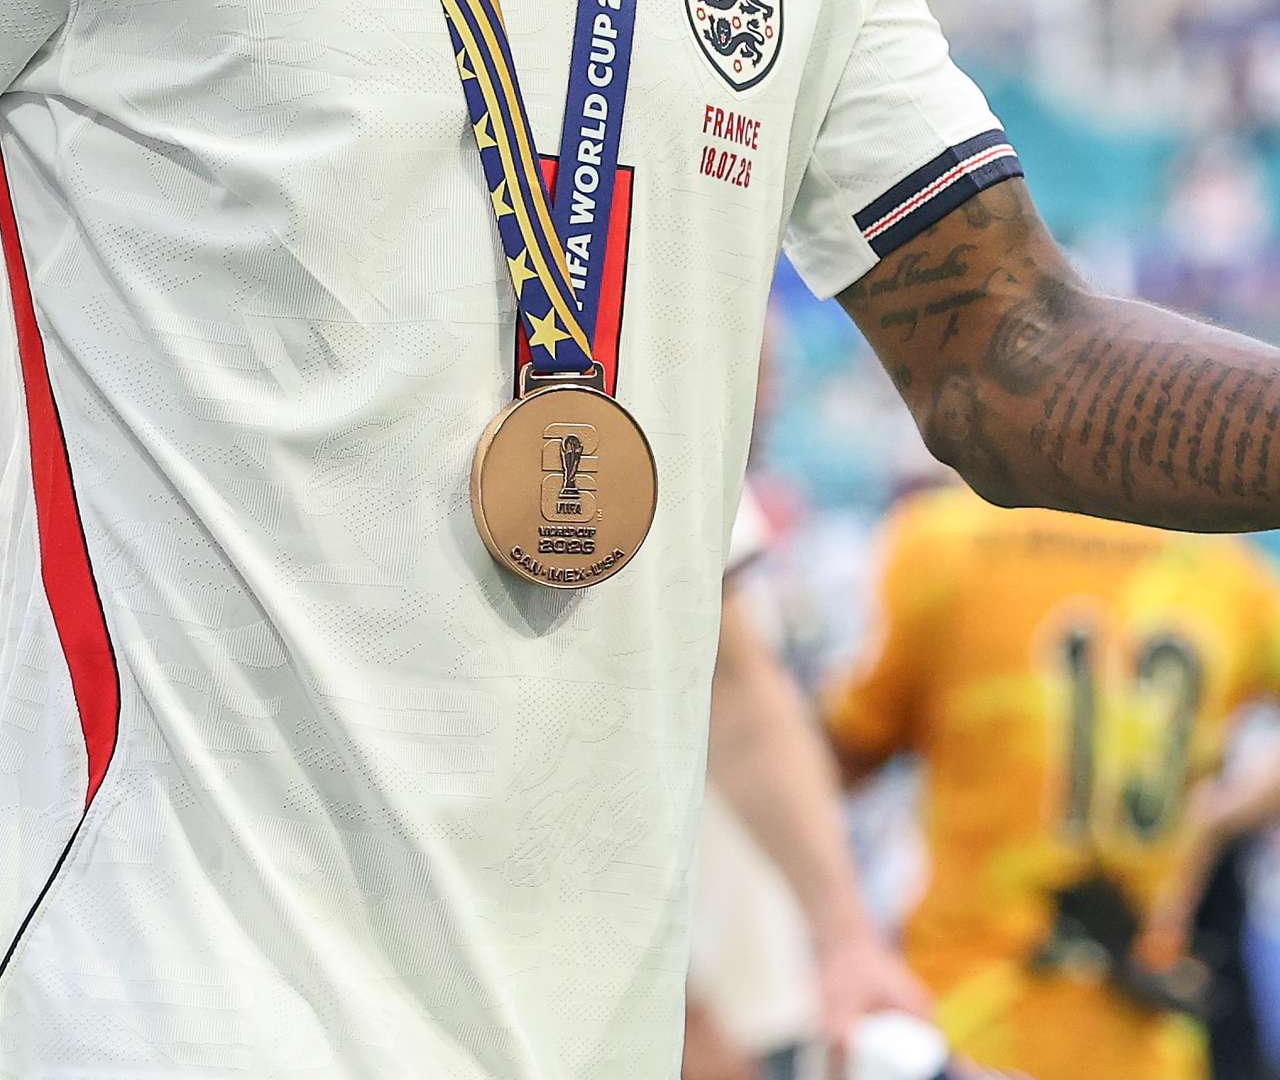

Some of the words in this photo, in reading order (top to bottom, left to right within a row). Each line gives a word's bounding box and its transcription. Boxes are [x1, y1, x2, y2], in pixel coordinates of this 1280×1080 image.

[586, 12, 619, 88] CUP
[702, 104, 762, 151] FRANCE
[568, 92, 609, 225] WORLD
[699, 145, 753, 189] 18.07.26
[565, 233, 593, 312] IFA
[537, 538, 596, 555] 2026
